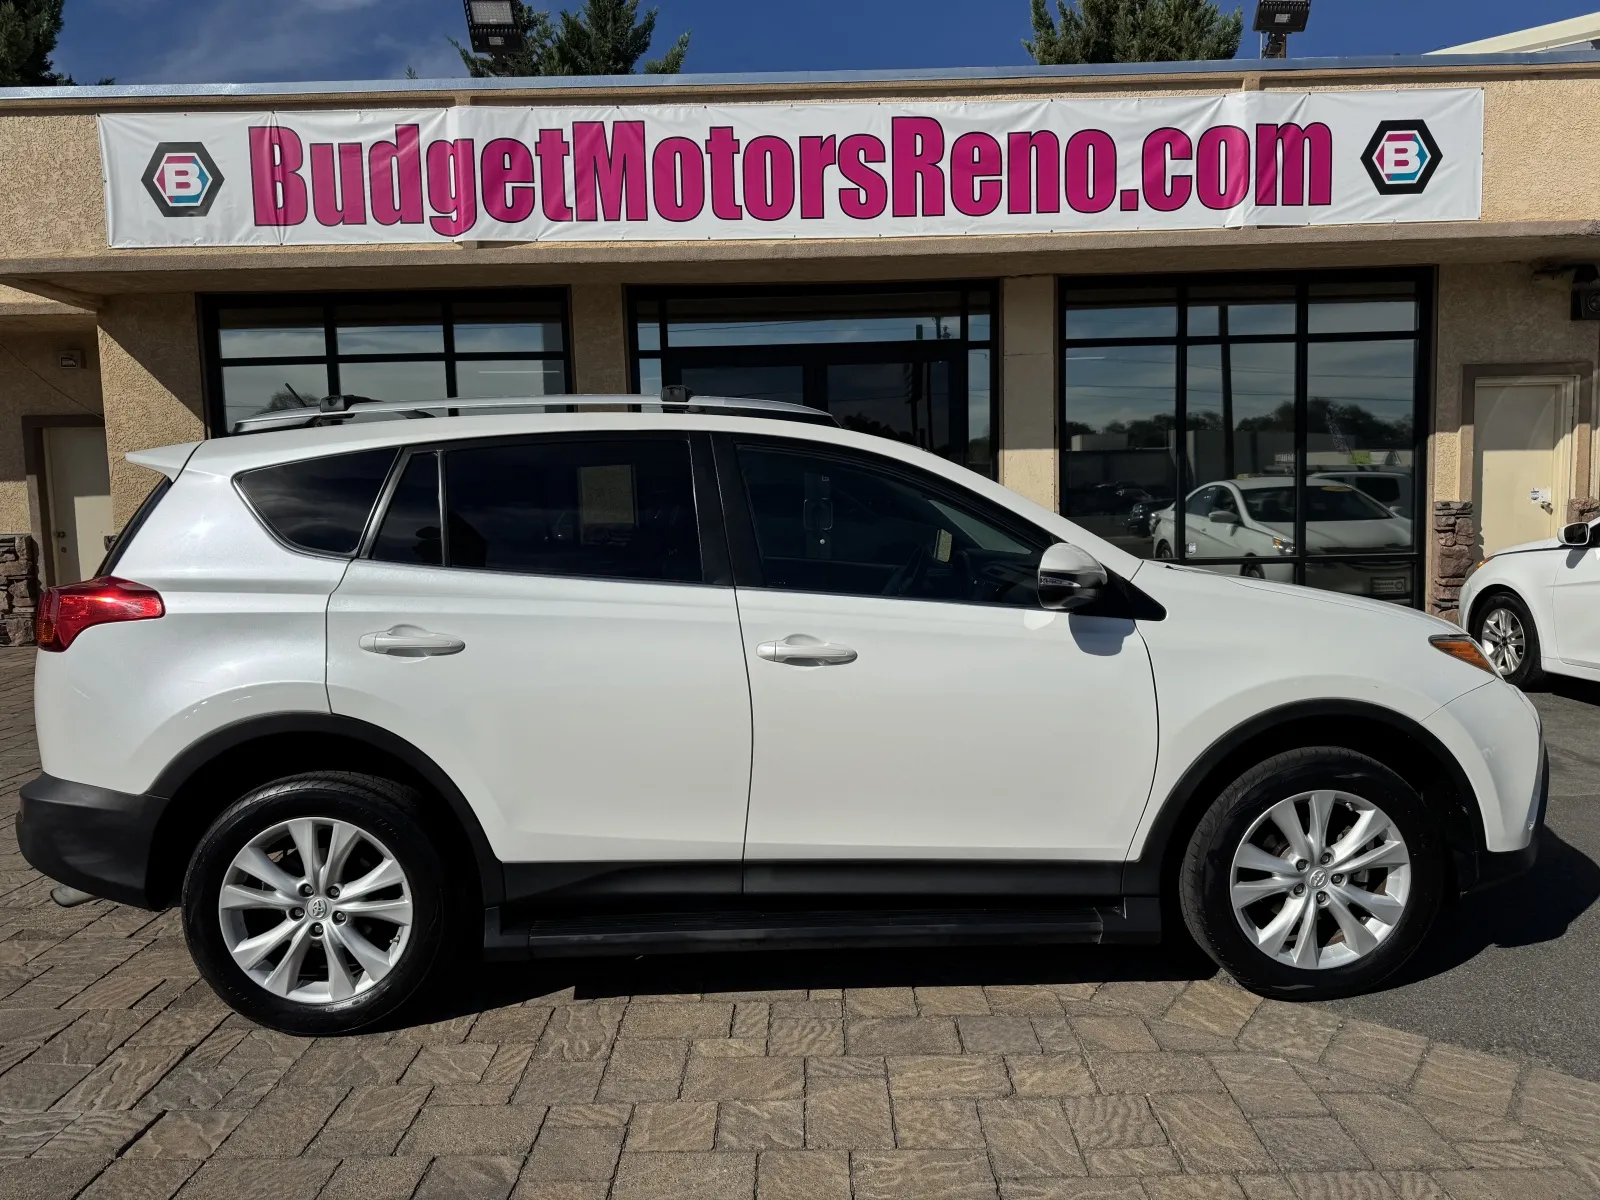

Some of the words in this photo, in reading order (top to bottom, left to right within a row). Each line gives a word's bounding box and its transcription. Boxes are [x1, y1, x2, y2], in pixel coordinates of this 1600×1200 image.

[1383, 140, 1421, 174] B
[163, 163, 203, 196] B
[249, 116, 1333, 236] BudgetMotorsReno.com
